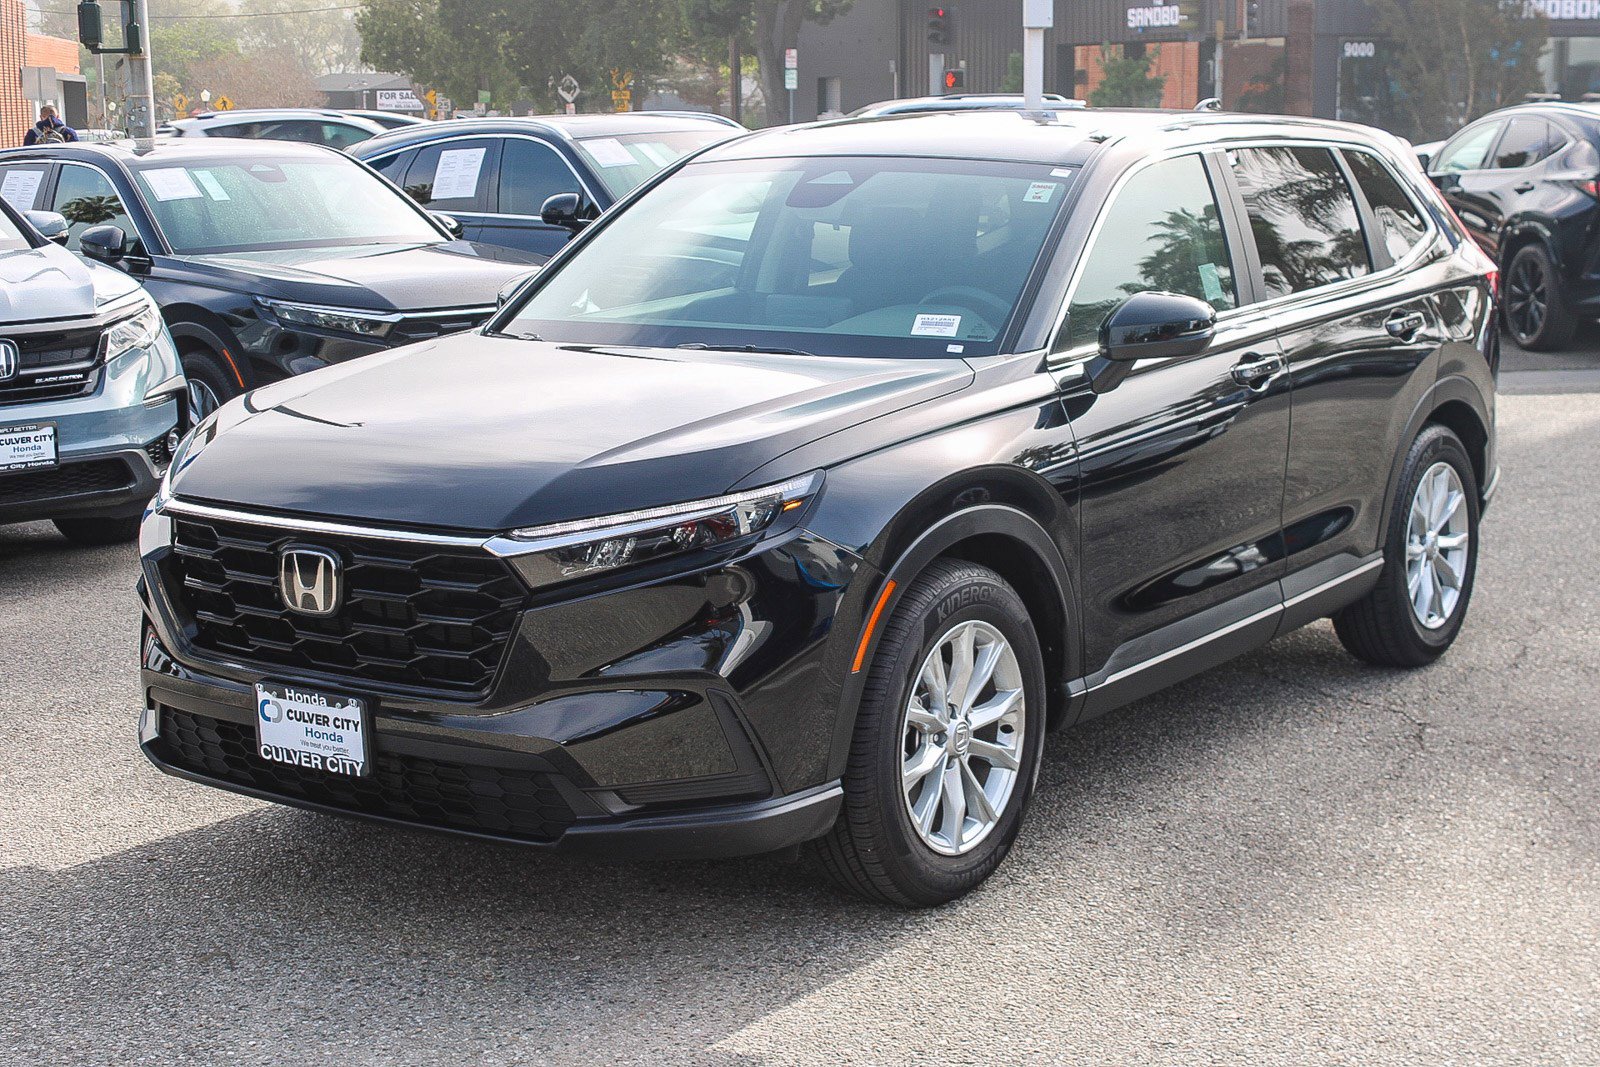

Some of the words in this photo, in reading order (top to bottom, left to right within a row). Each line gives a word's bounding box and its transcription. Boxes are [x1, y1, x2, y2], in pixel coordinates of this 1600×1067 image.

[1344, 42, 1375, 57] 9000
[380, 92, 396, 100] FOR
[398, 91, 416, 100] SAL
[35, 376, 58, 384] BLACK
[0, 436, 31, 446] CULVER
[33, 434, 54, 443] CITY
[13, 444, 42, 453] Honda
[9, 462, 27, 470] City
[27, 459, 55, 468] Honda
[937, 585, 997, 623] KINERGY
[285, 688, 327, 707] Honda
[286, 708, 330, 727] CULVER
[332, 716, 360, 732] CITY
[304, 727, 343, 743] Honda
[260, 744, 322, 770] CULVER
[326, 756, 363, 777] CITY
